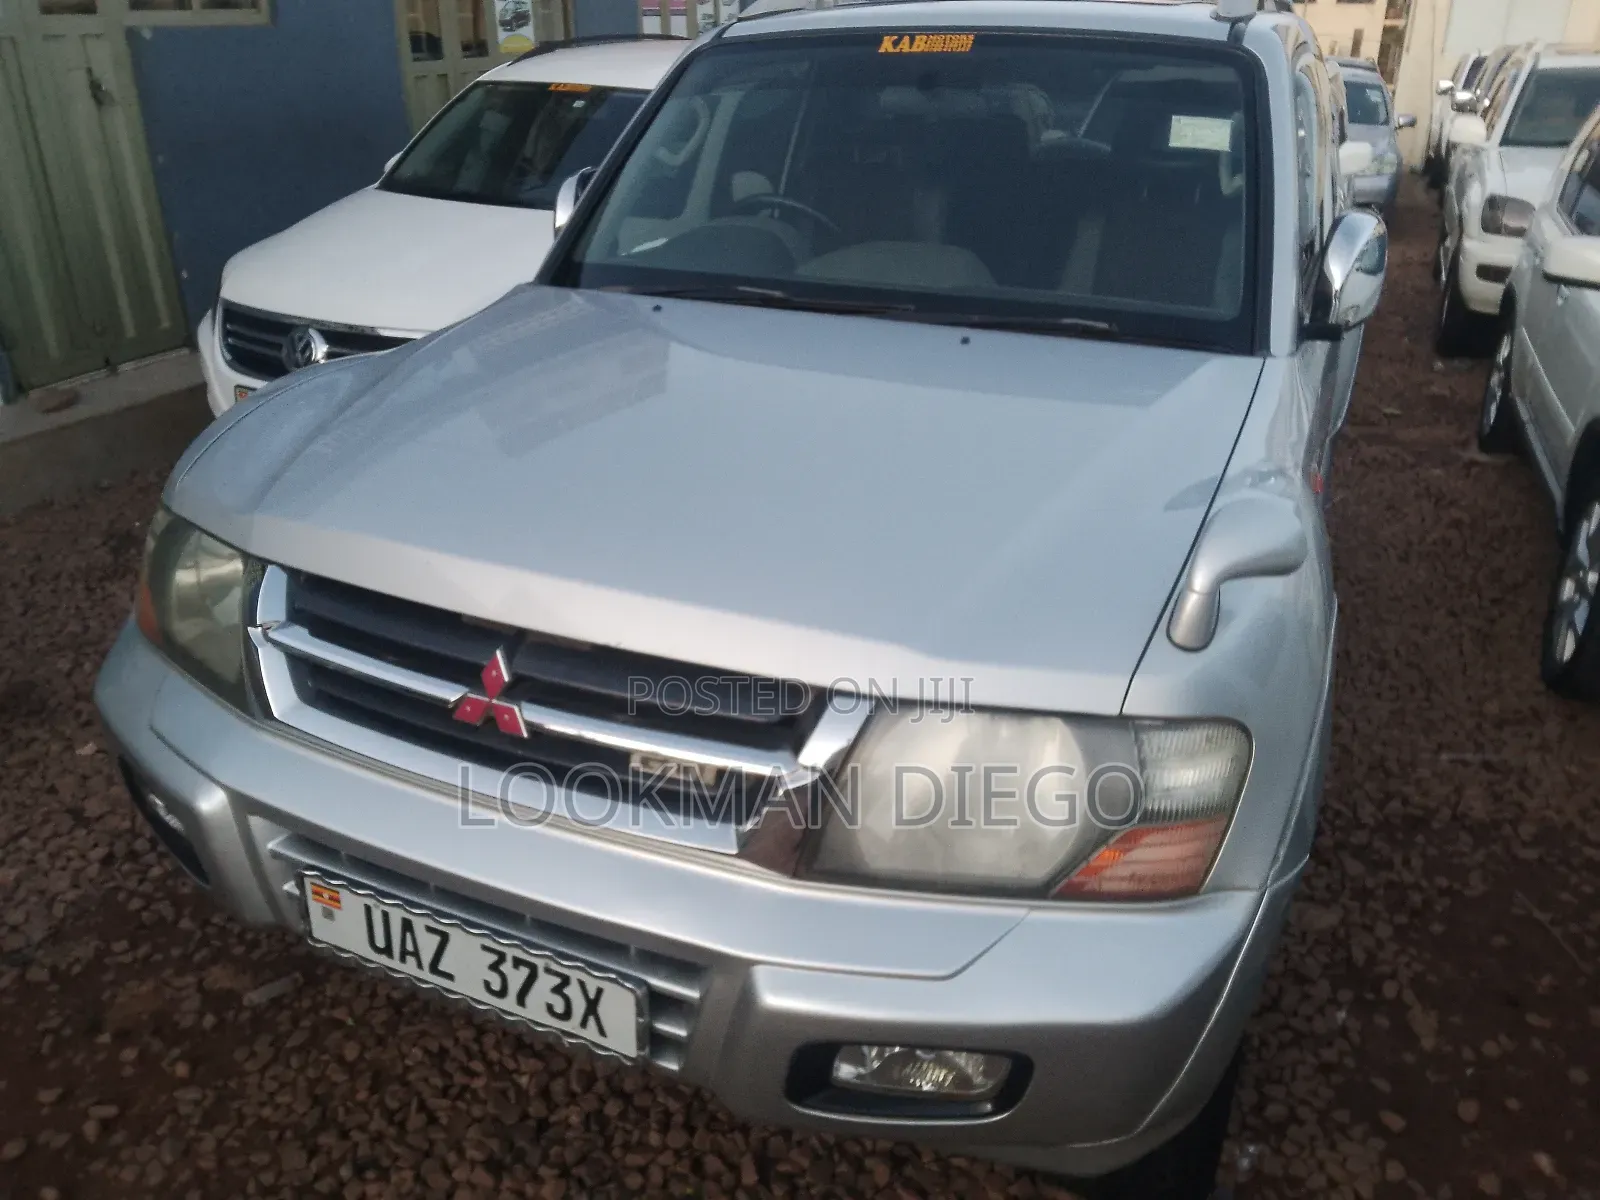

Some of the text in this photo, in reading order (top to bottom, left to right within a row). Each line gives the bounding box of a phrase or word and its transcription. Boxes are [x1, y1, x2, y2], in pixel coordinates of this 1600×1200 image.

[878, 35, 927, 53] KAB
[363, 902, 608, 1039] UAZ 373X
